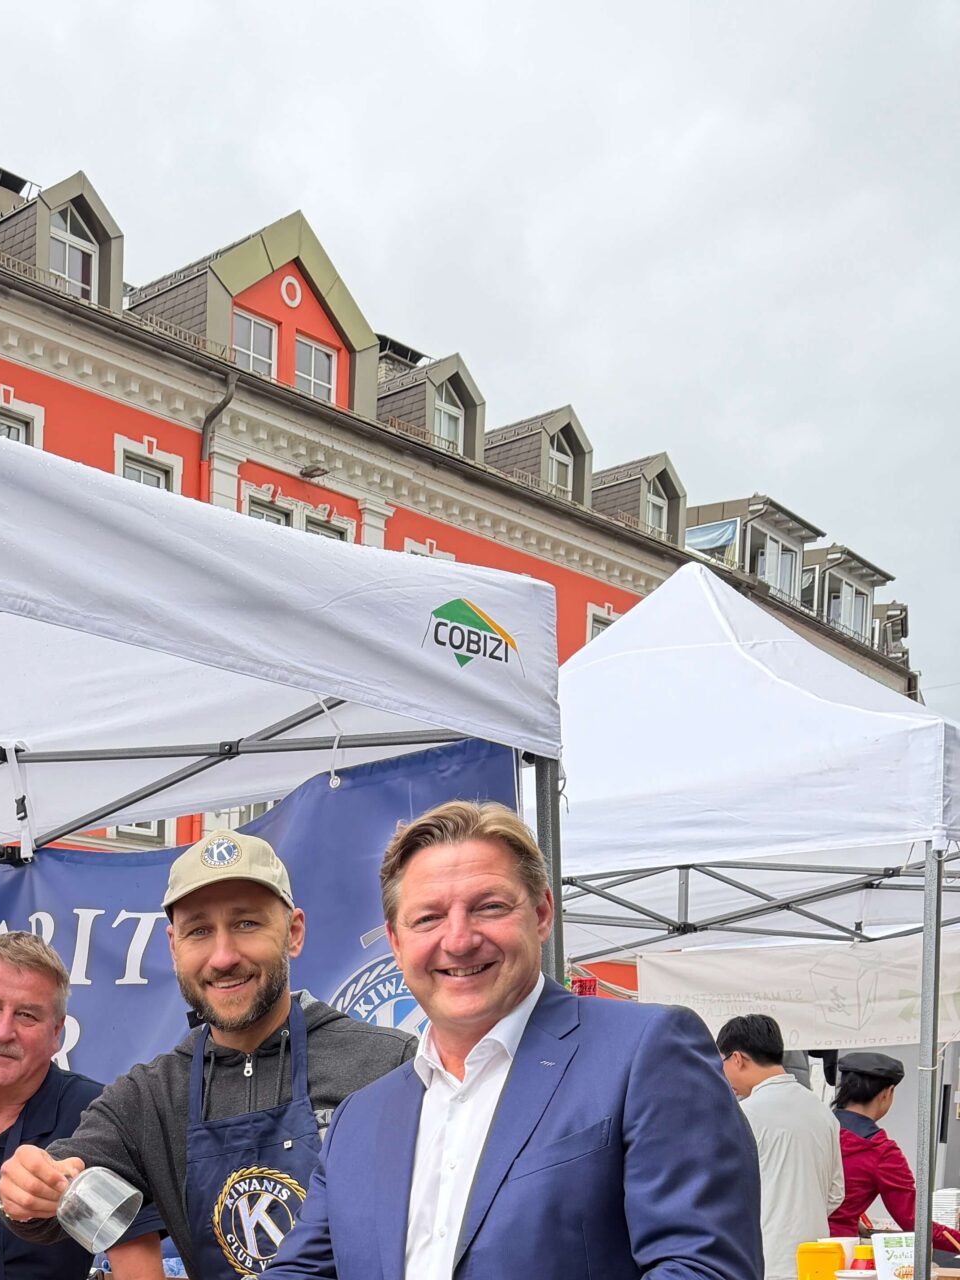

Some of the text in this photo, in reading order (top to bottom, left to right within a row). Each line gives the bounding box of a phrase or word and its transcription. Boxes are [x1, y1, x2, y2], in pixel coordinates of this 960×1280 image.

[434, 621, 508, 663] COBIZI
[224, 1178, 291, 1210] KIWANIS
[237, 1193, 285, 1258] K
[226, 1234, 253, 1268] CLUB
